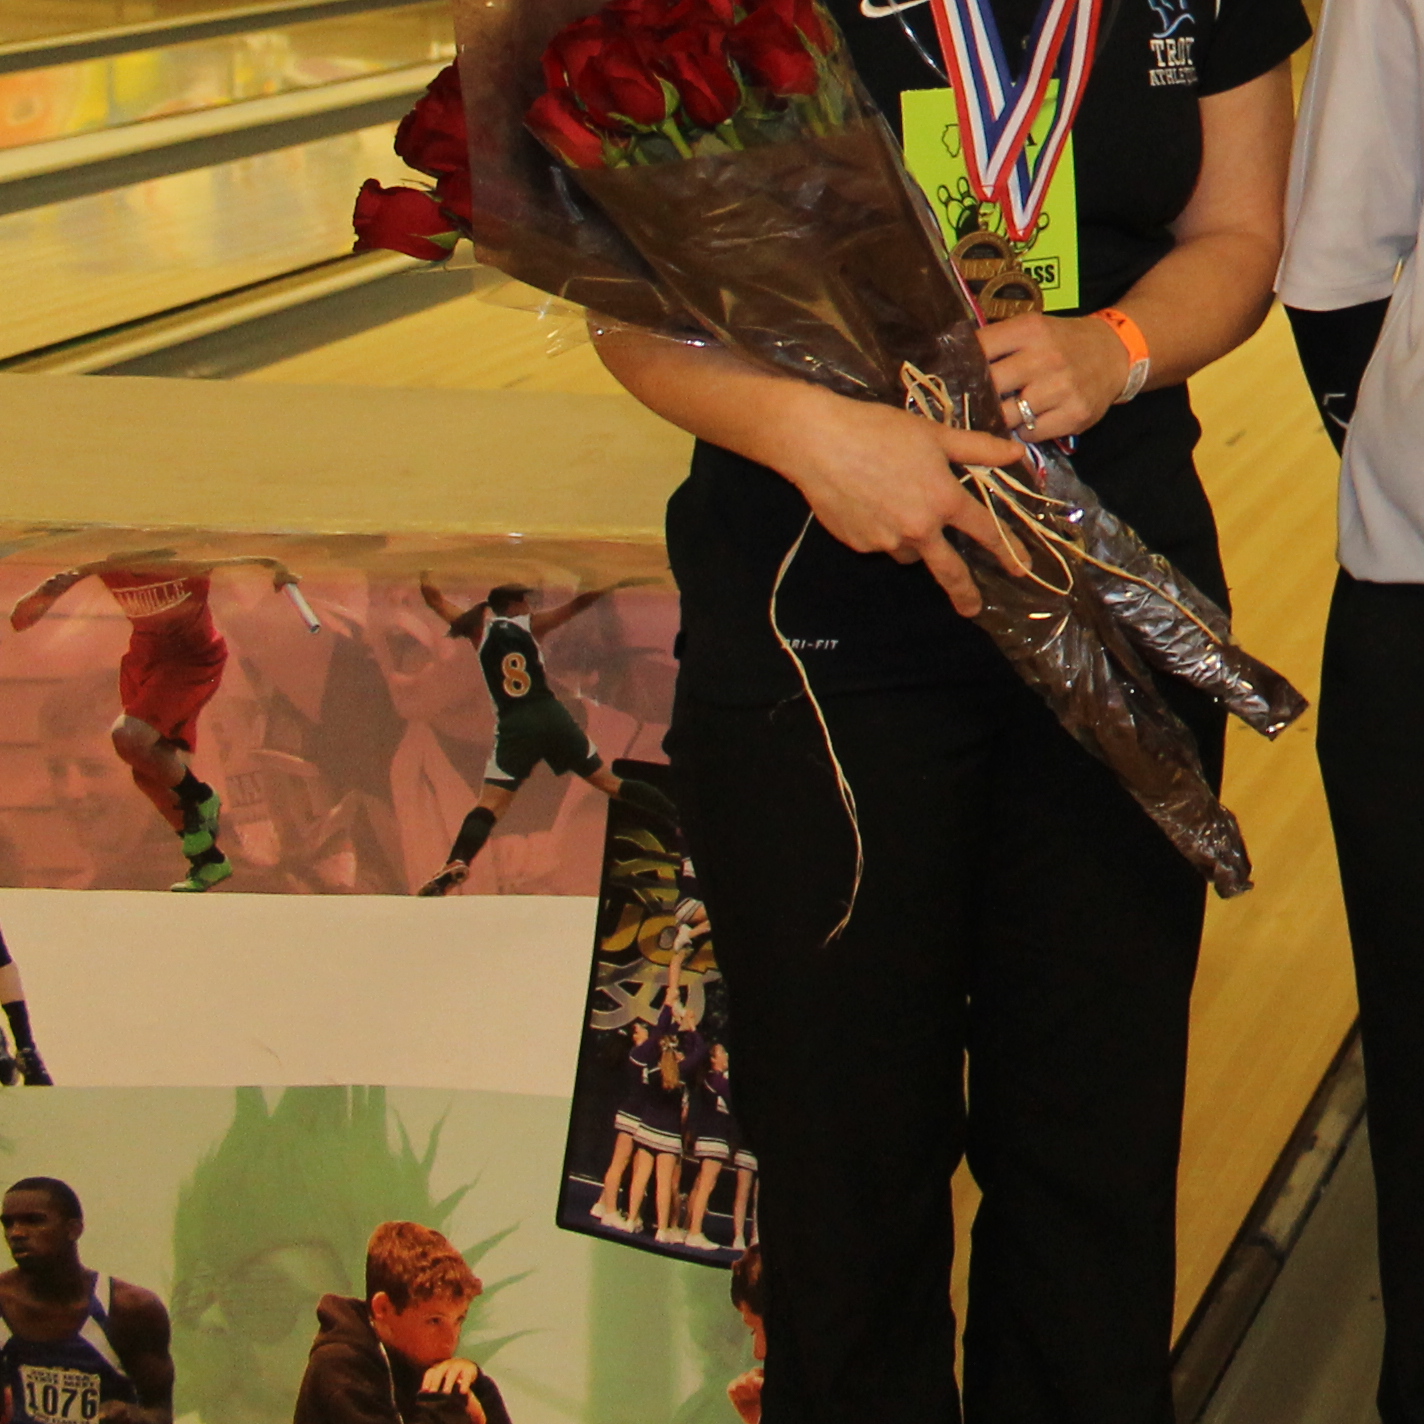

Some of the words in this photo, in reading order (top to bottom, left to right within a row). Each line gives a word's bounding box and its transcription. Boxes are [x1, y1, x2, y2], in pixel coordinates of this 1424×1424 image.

[1149, 37, 1195, 67] TROY
[1025, 264, 1055, 284] ASS
[501, 651, 532, 697] 8
[26, 1381, 98, 1420] 1076
